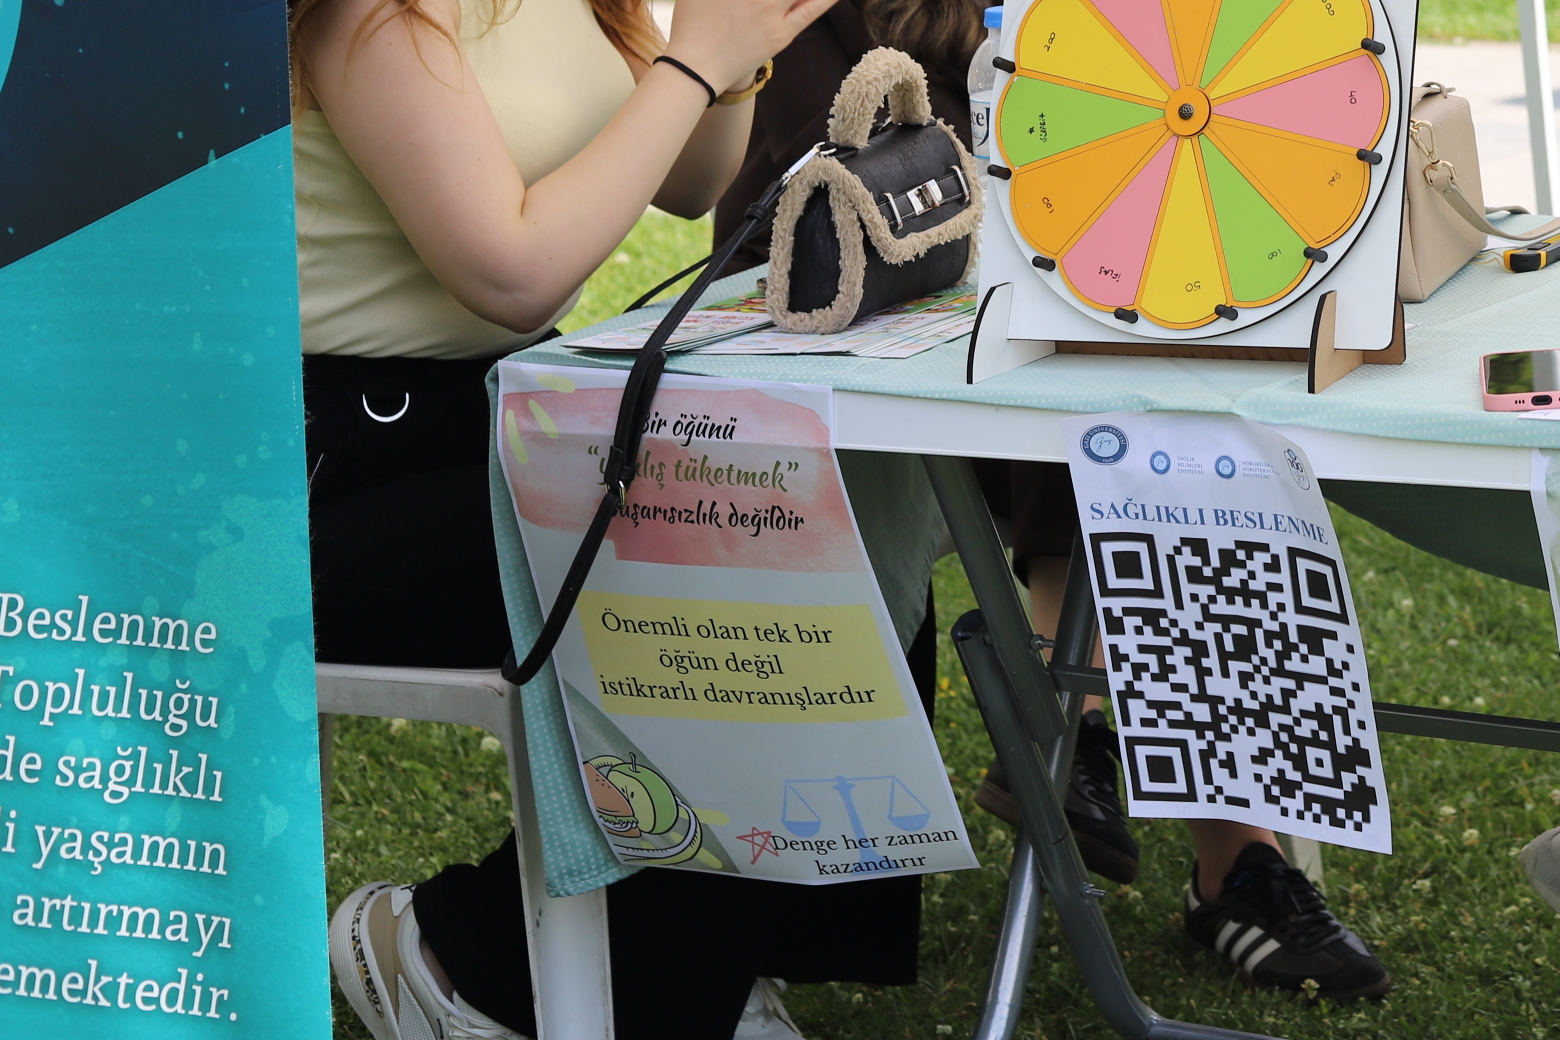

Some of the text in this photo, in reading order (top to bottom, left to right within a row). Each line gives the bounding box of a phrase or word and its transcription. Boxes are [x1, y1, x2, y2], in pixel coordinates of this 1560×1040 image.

[1043, 32, 1056, 52] 200
[1348, 90, 1357, 105] 40
[1185, 280, 1201, 292] 50
[672, 413, 738, 447] öğünü
[612, 499, 805, 537] aşarısızlık değildir
[1089, 497, 1329, 545] SAĞLIKLI BESLENME
[0, 593, 218, 653] Beslenme
[601, 608, 833, 645] Önemli olan tek bir
[659, 649, 785, 680] öğün değil
[600, 676, 876, 711] istikrarlı davranışlardır
[55, 746, 223, 804] sağlıklı
[32, 821, 227, 876] yaşamın
[770, 828, 960, 857] Denge her zaman
[814, 852, 927, 877] kazandırır
[12, 893, 232, 957] artırmayı
[0, 959, 238, 1022] emektedir.
